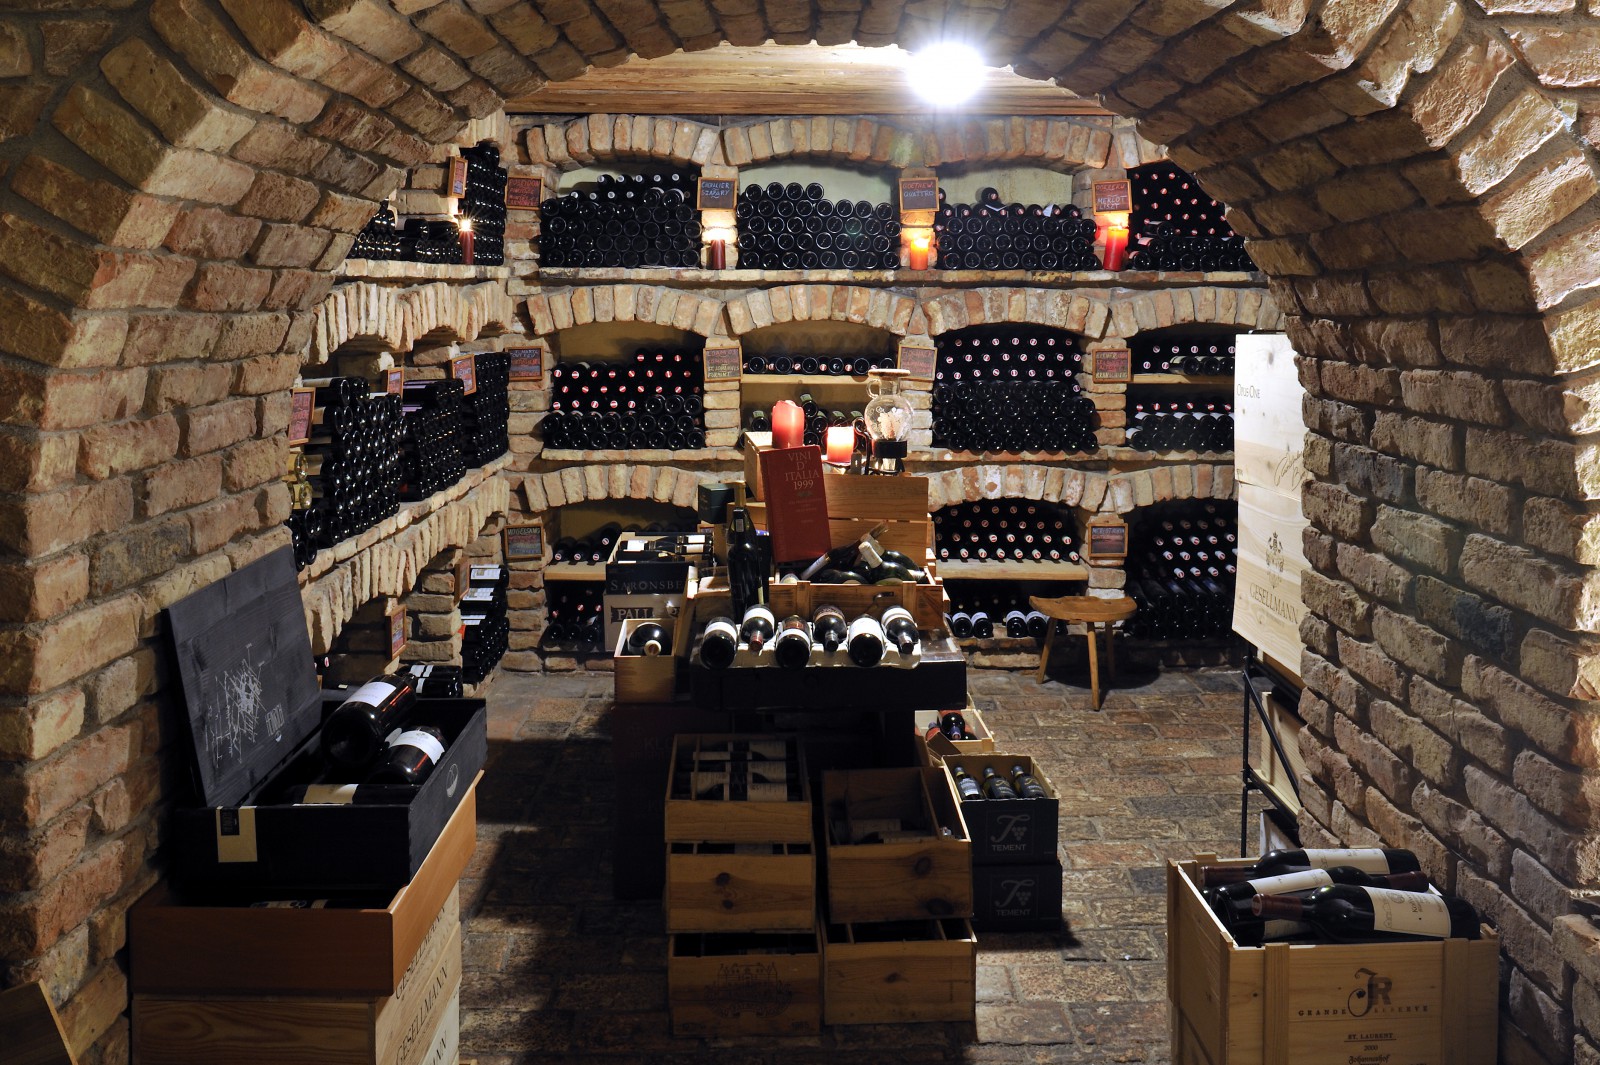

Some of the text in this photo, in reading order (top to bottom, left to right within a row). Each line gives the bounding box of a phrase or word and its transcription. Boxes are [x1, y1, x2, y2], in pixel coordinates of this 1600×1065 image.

[1097, 195, 1128, 204] MERLOT
[787, 450, 812, 461] VINI
[785, 471, 820, 481] ITALIA
[793, 480, 814, 490] 1999
[1249, 583, 1299, 625] GESELLMANN
[991, 843, 1027, 852] TEMENT
[996, 908, 1031, 917] TEMENT
[396, 960, 449, 1065] GESELLMANN
[1298, 1008, 1347, 1017] GRANDE
[1360, 1032, 1394, 1040] LAURENT
